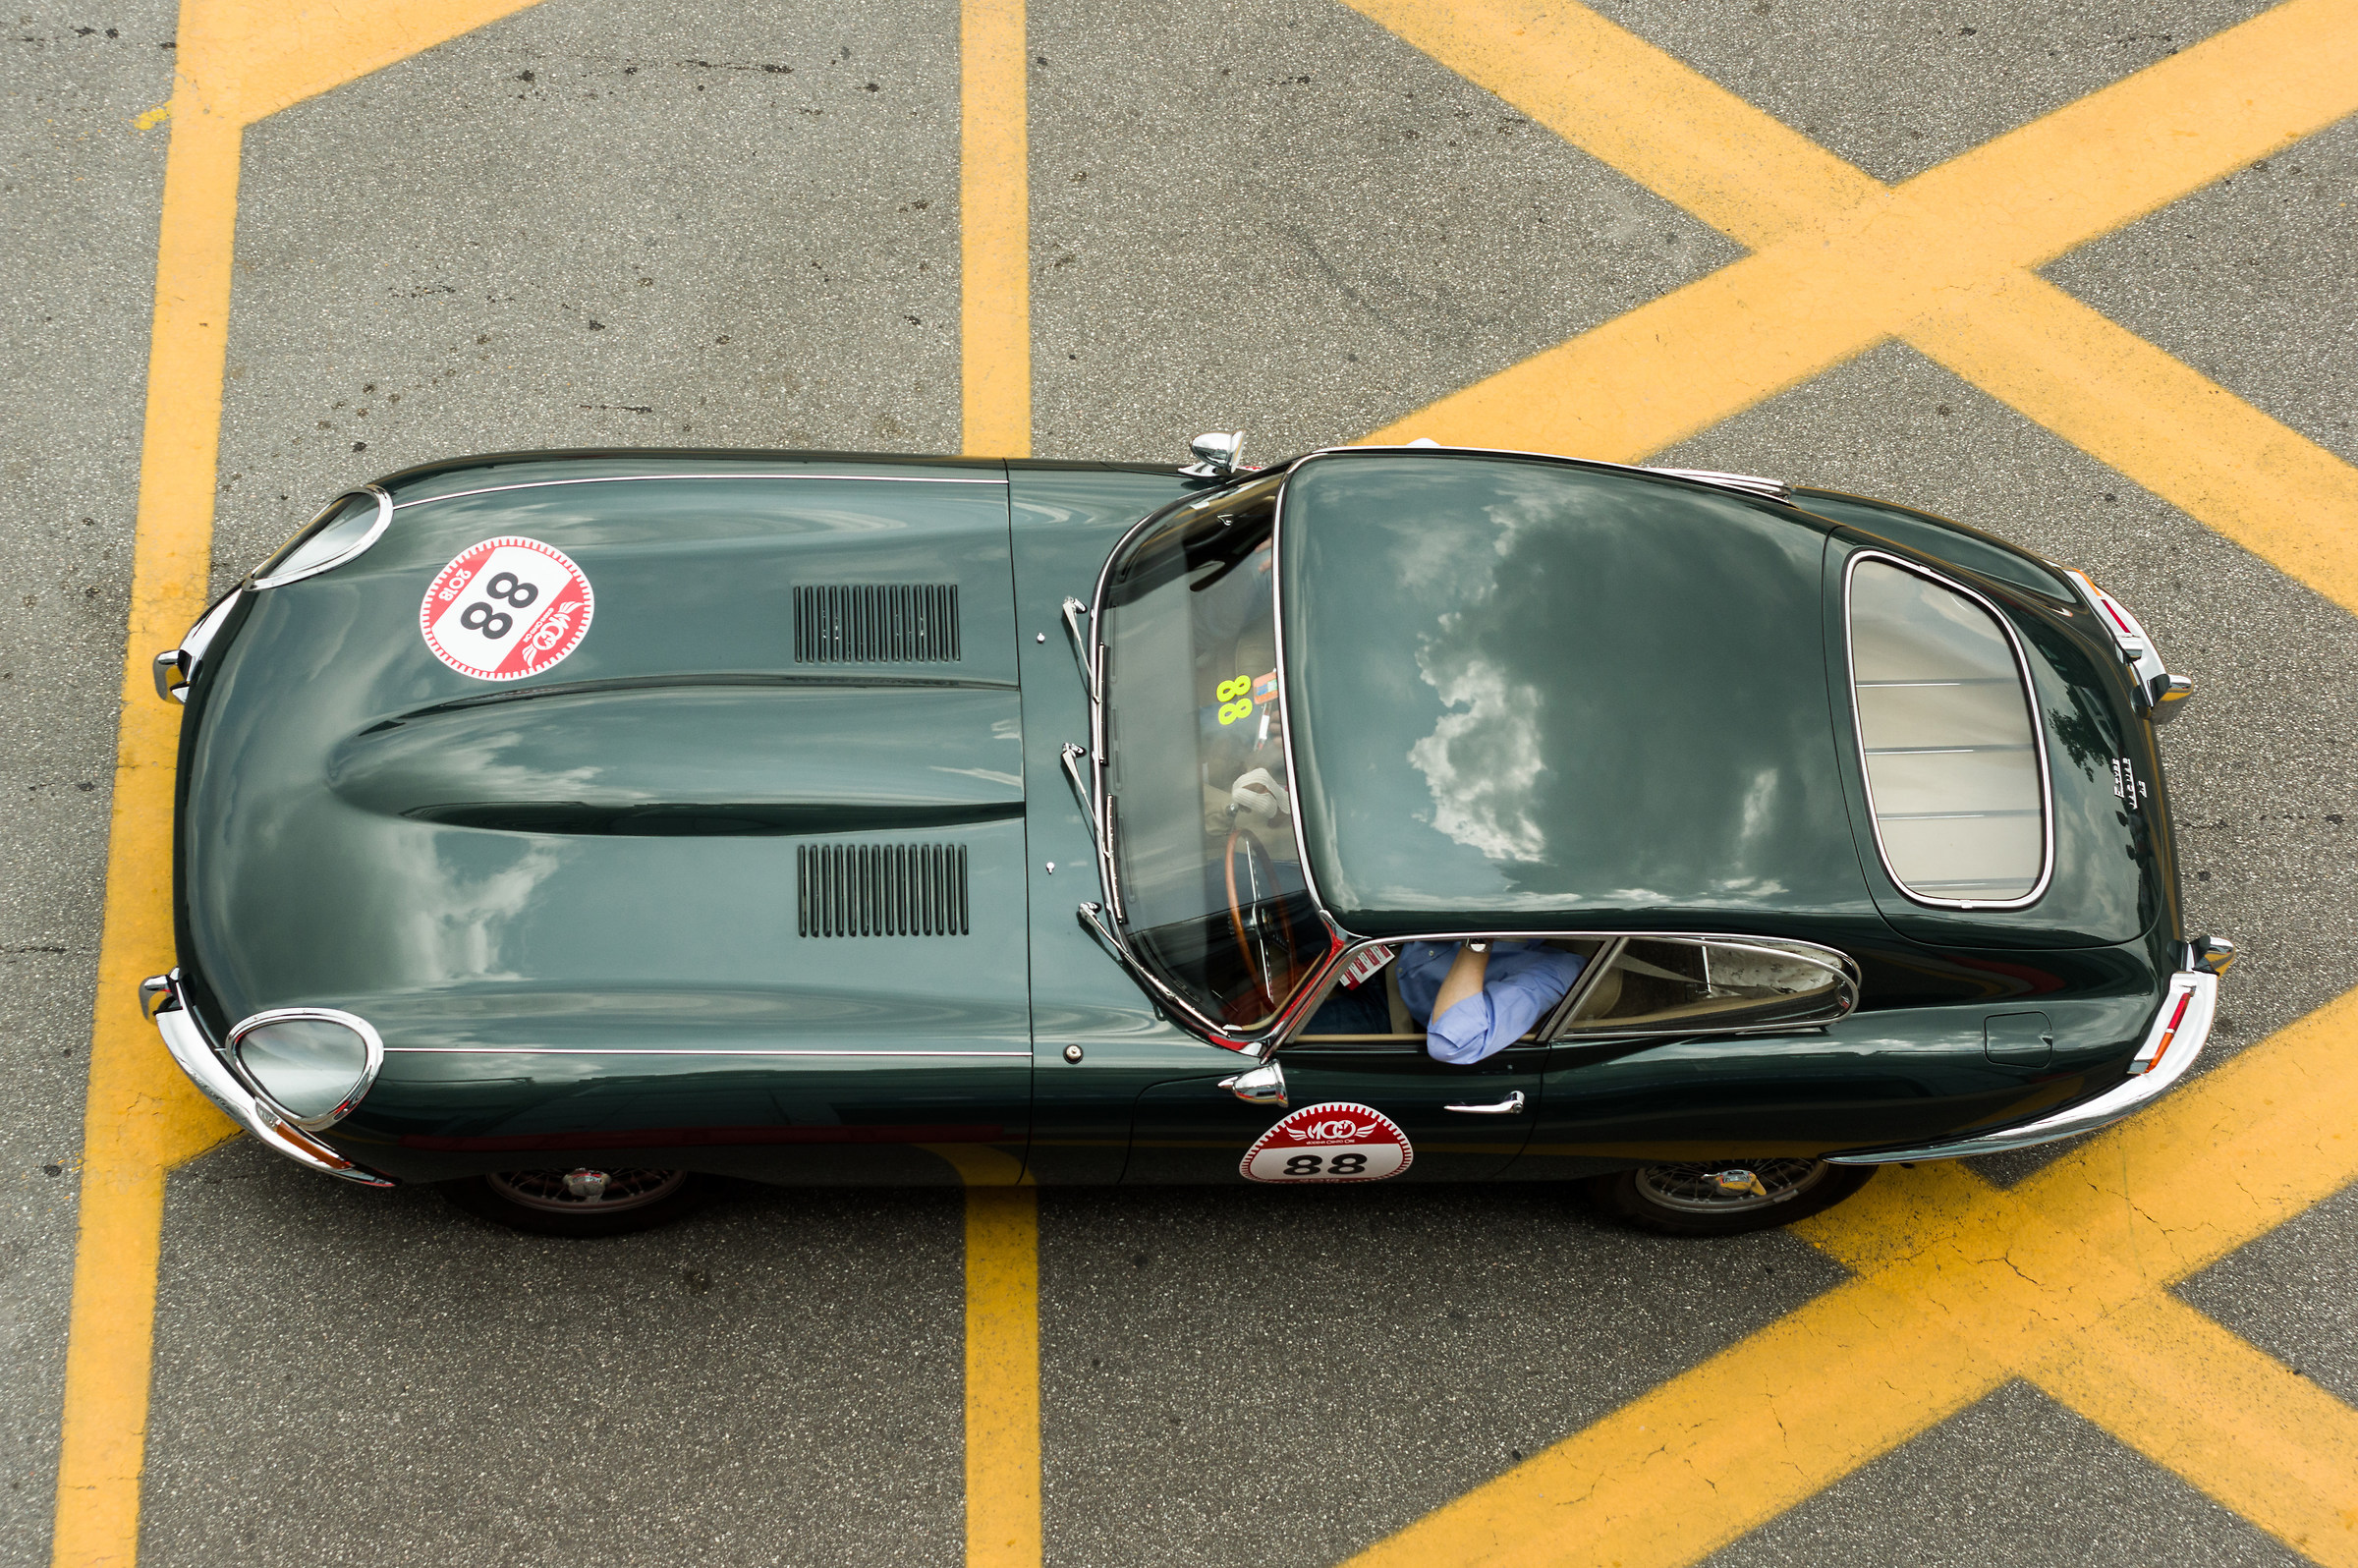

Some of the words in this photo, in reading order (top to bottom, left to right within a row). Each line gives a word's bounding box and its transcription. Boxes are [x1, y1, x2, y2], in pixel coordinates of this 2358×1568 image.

[438, 568, 472, 601] 2018
[461, 572, 538, 640] 88
[1216, 675, 1253, 725] 88
[2123, 757, 2138, 809] JAGUAR
[1283, 1153, 1367, 1175] 88
